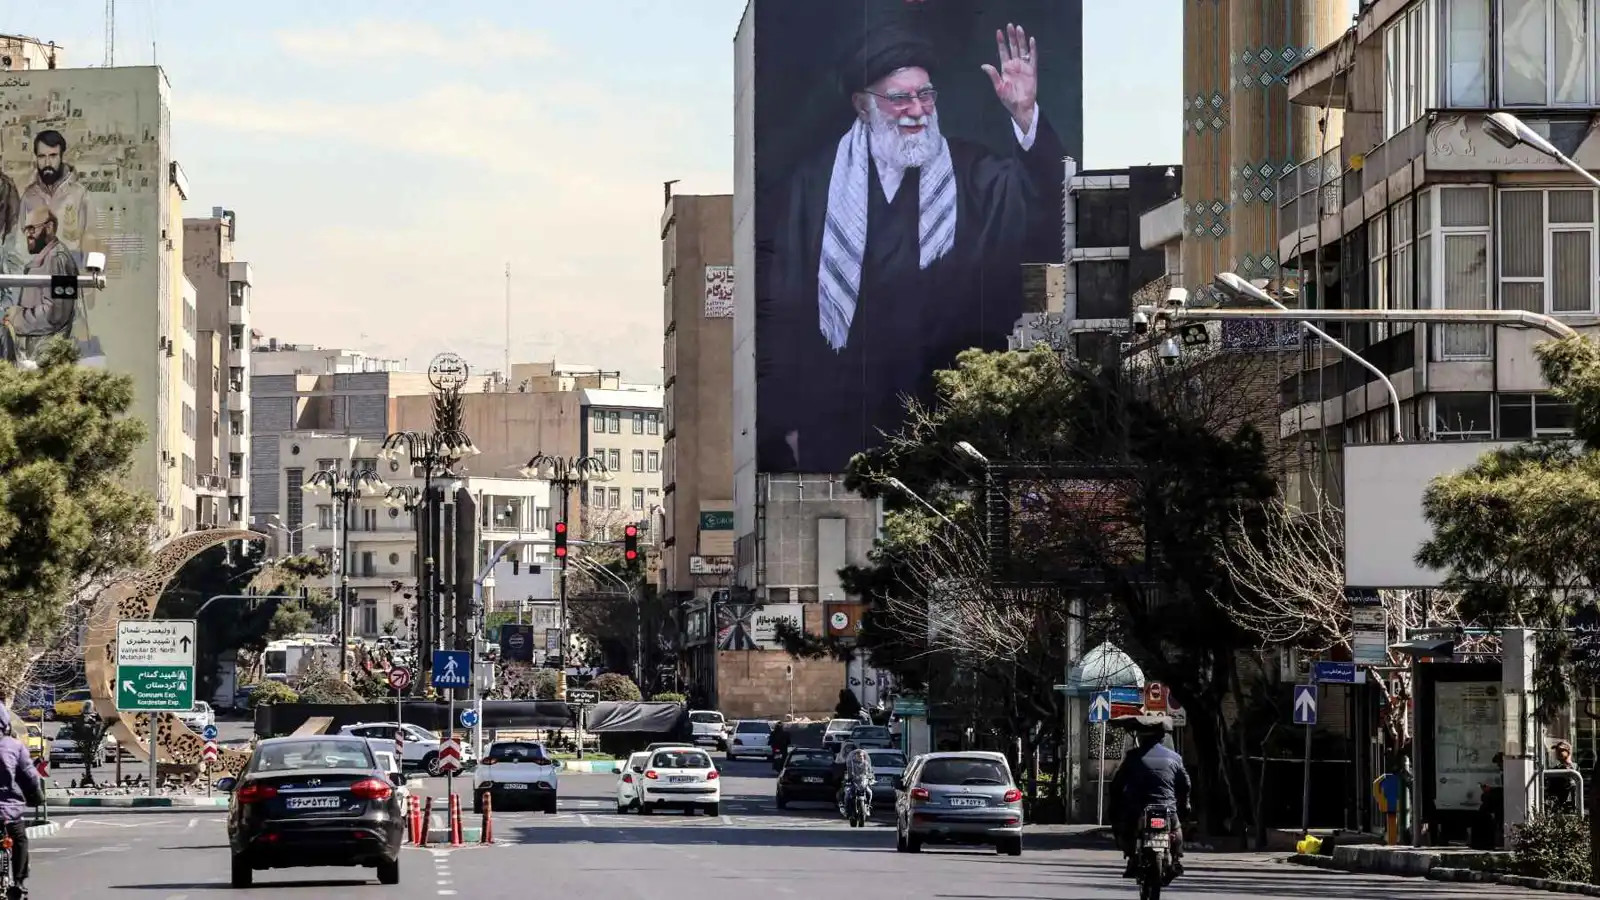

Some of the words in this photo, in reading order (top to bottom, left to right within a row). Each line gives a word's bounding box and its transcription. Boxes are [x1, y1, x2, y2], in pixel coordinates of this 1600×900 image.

[138, 670, 159, 680] گمنام
[159, 671, 177, 679] شهید
[145, 681, 177, 690] کردستان
